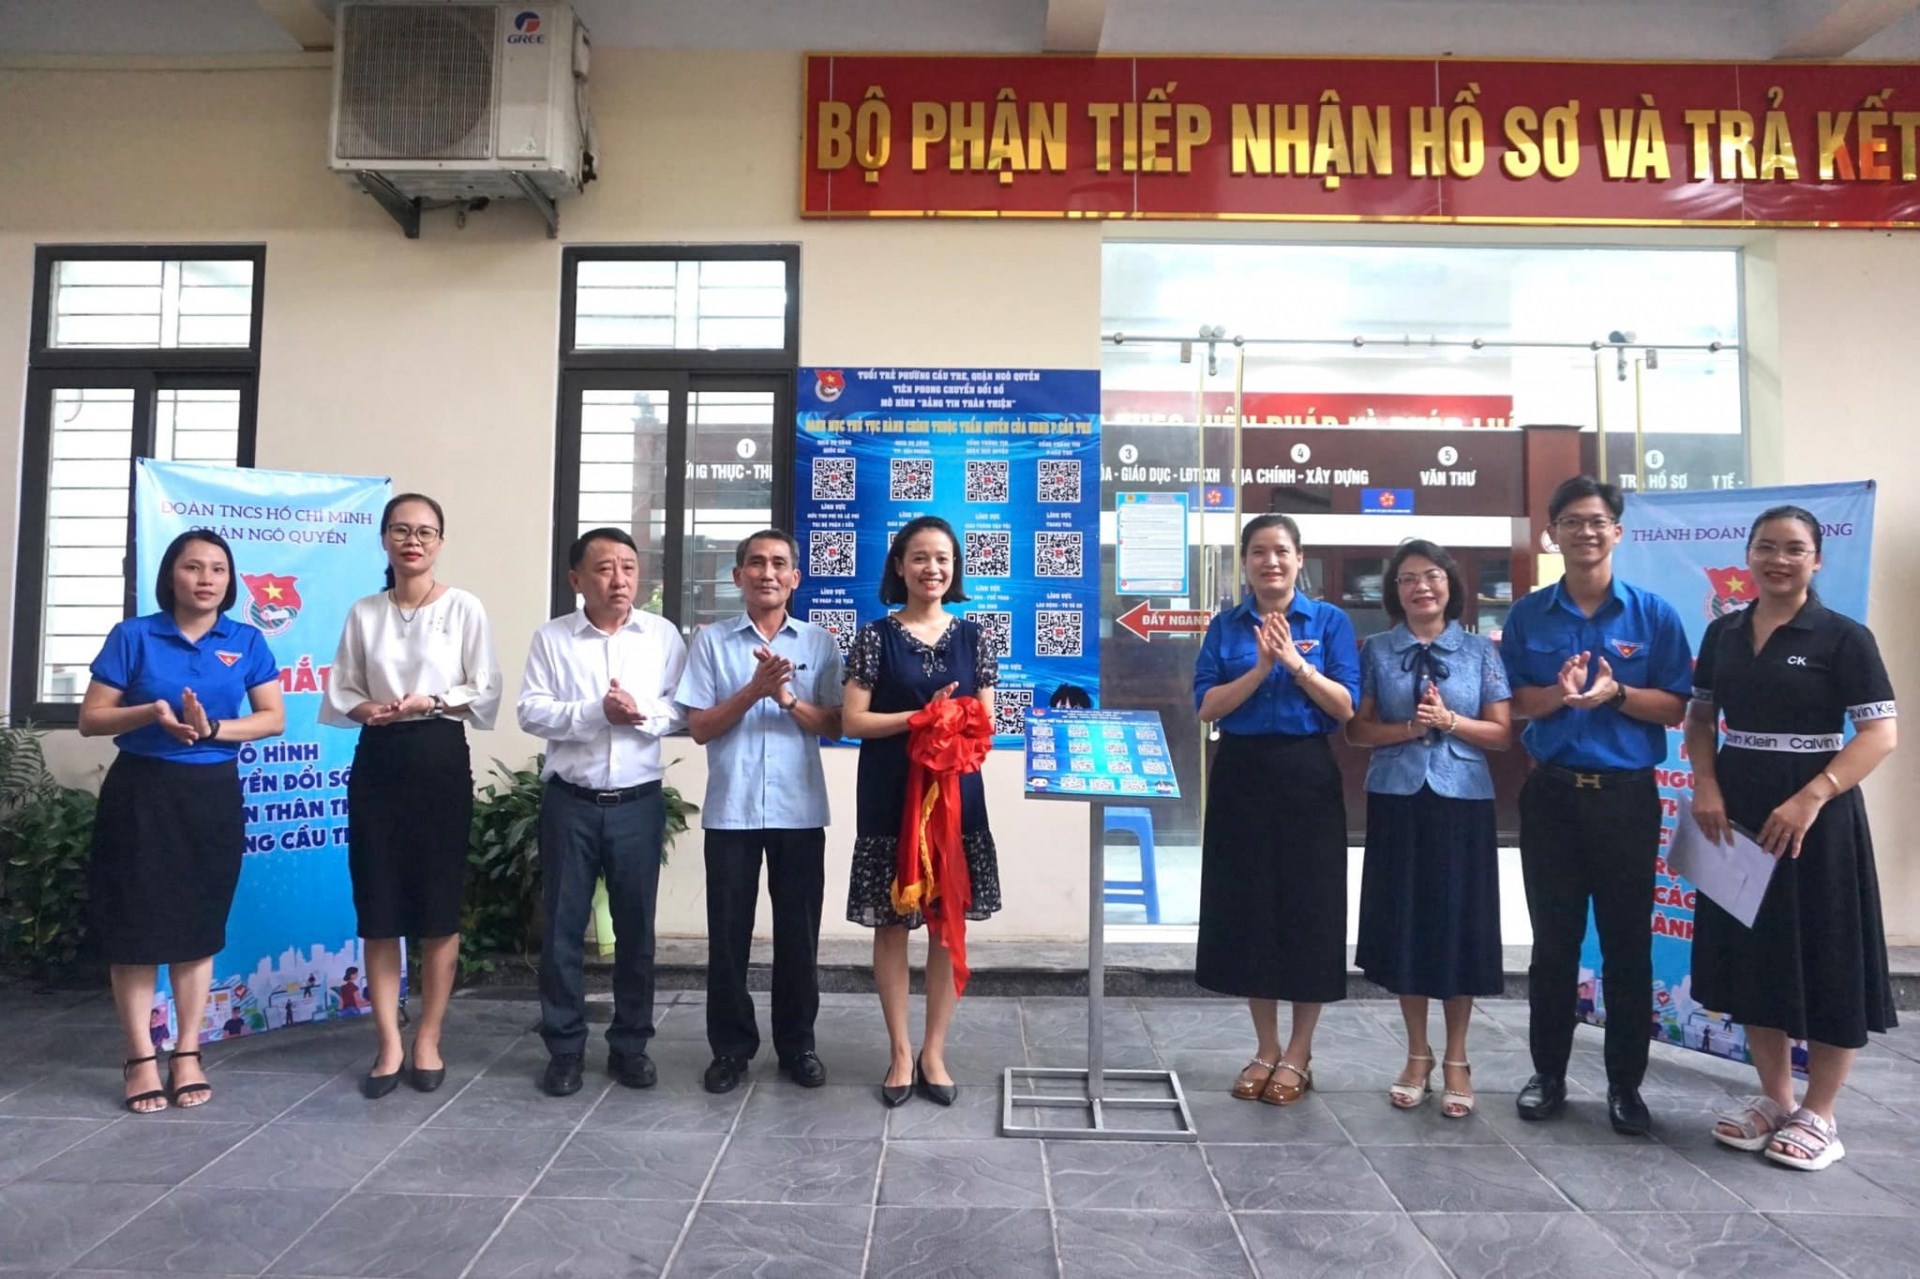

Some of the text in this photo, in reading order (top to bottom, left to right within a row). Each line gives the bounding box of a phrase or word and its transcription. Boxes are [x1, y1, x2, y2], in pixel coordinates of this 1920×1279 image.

[507, 35, 544, 44] GREE
[817, 81, 1920, 189] BỘ PHẬN TIẾP NHẬN HỒ SƠ VÀ TRẢ KẾT
[710, 464, 745, 482] THỰC
[1121, 462, 1147, 482] GIÁO
[1149, 467, 1171, 485] DỤC
[1256, 465, 1296, 483] CHÍNH
[1305, 467, 1330, 484] XÂY
[1334, 468, 1369, 487] DỰNG
[1420, 468, 1477, 486] VĂN THƯ
[1670, 472, 1688, 489] SƠ
[1711, 475, 1719, 489] Y
[161, 501, 214, 516] ĐOÀN
[219, 504, 262, 519] TNCS
[328, 510, 372, 525] MINH
[248, 527, 285, 542] NGÔ
[1631, 526, 1691, 541] THÀNH
[1695, 525, 1746, 540] ĐOÀN
[1787, 655, 1807, 667] CK
[1743, 735, 1778, 748] Klein
[1789, 736, 1834, 750] Calvin
[263, 741, 319, 763] HÌNH
[283, 765, 322, 791] ĐỔI
[265, 798, 324, 822] THÂN
[280, 824, 326, 849] CẦU
